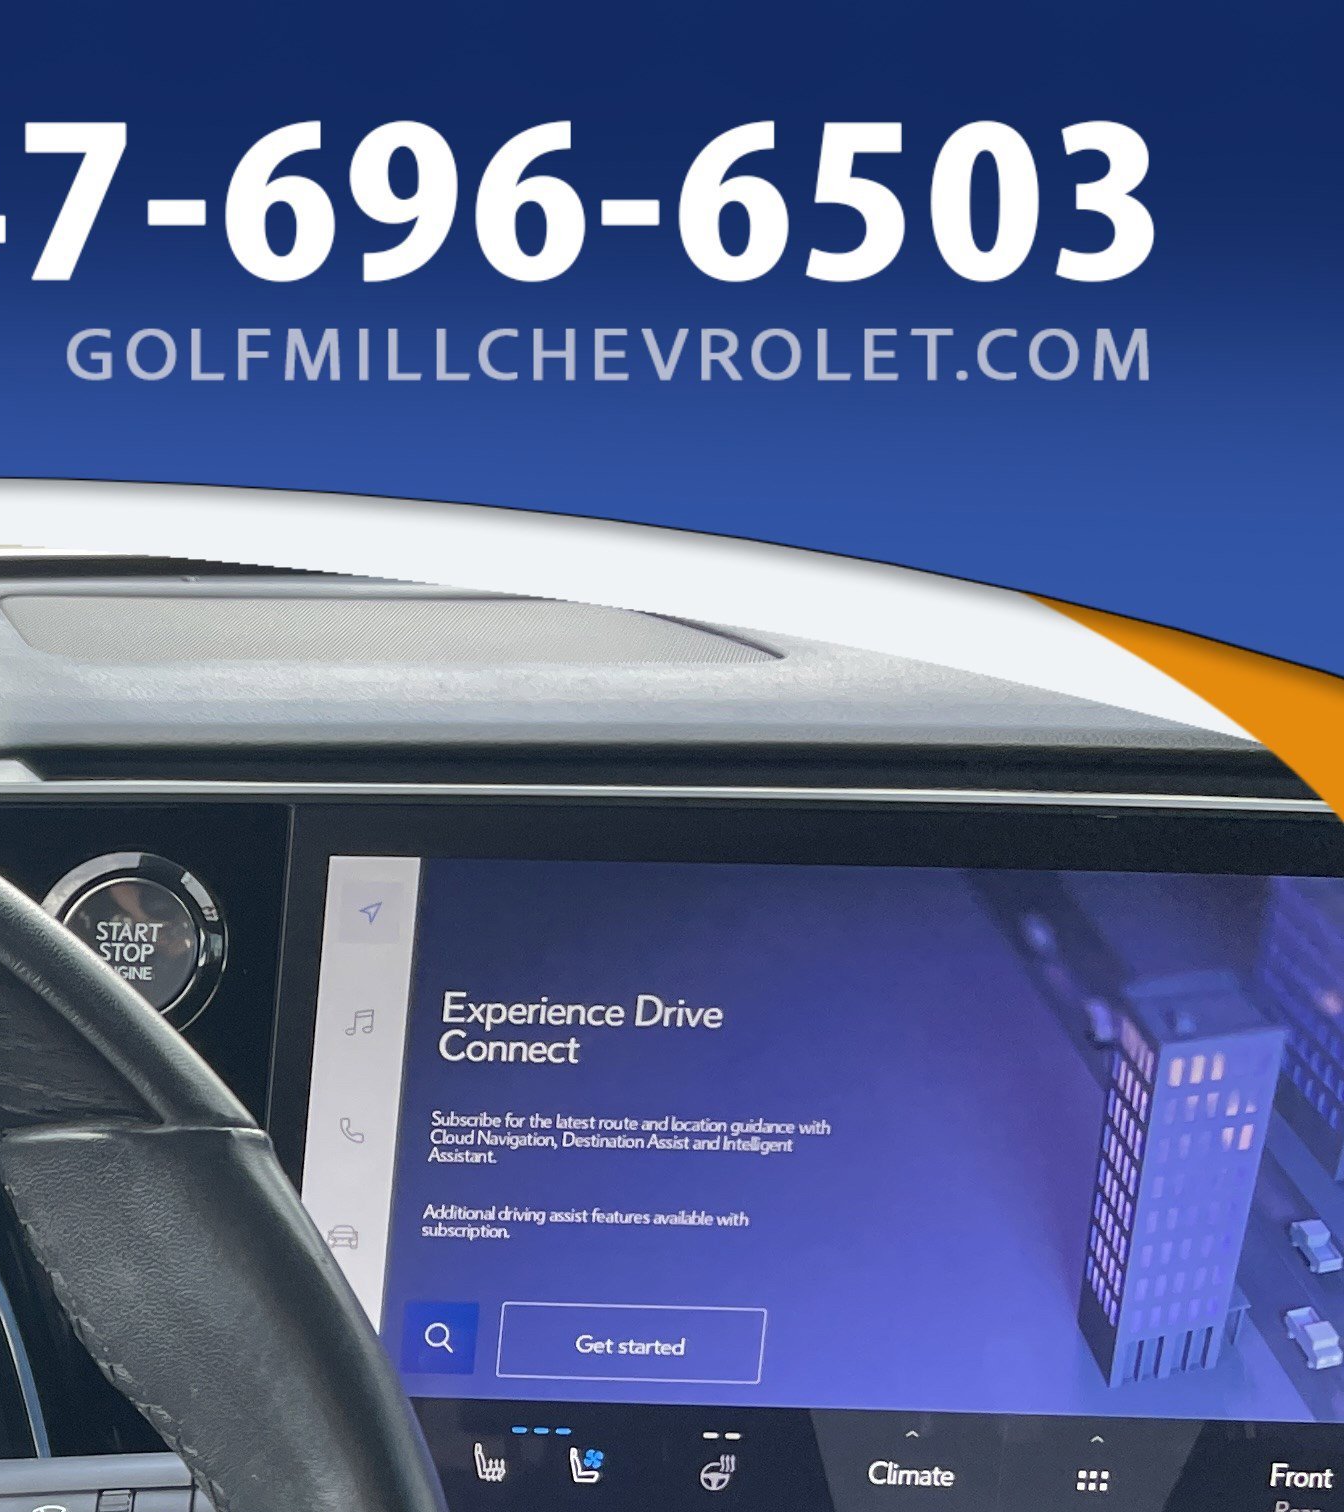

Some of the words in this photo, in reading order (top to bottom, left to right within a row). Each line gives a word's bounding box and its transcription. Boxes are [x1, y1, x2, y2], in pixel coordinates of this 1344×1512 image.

[96, 921, 163, 943] START
[99, 943, 155, 963] STOP
[113, 966, 153, 981] GINE
[441, 990, 625, 1031] Experience
[634, 993, 724, 1029] Drive
[437, 1029, 581, 1064] Connect
[430, 1110, 502, 1128] Subscribe
[504, 1112, 526, 1128] for
[529, 1113, 553, 1129] the
[555, 1113, 595, 1130] latest
[598, 1116, 638, 1131] route
[641, 1115, 668, 1132] and
[670, 1116, 727, 1133] location
[730, 1117, 795, 1137] guidance
[798, 1119, 831, 1135] with
[429, 1129, 475, 1145] Cloud
[477, 1130, 558, 1150] Navigation,
[562, 1131, 645, 1149] Destination
[647, 1133, 690, 1150] Assist
[692, 1135, 721, 1151] and
[722, 1135, 794, 1155] Intelligent
[427, 1146, 497, 1164] Assistant.
[422, 1204, 496, 1221] Additional
[497, 1206, 546, 1225] driving
[549, 1208, 588, 1223] assist
[591, 1207, 651, 1224] features
[653, 1210, 714, 1226] available
[716, 1211, 750, 1227] with
[421, 1222, 511, 1240] subscription.
[575, 1335, 614, 1355] Get
[618, 1337, 686, 1356] started
[867, 1460, 956, 1489] Climate
[1268, 1462, 1335, 1489] Front
